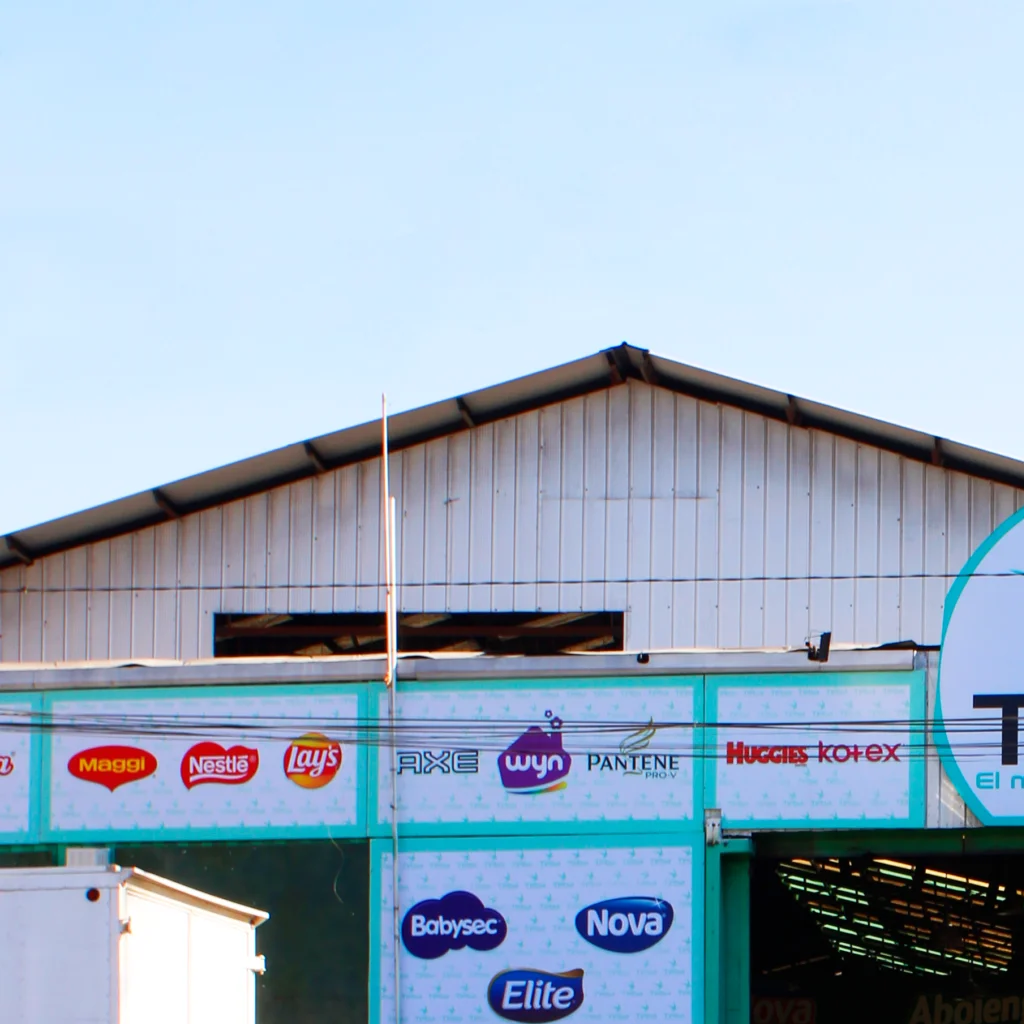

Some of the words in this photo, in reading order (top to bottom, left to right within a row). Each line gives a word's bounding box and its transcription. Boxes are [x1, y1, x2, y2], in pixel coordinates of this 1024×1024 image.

[287, 745, 339, 777] Lay's
[397, 751, 479, 774] AXE
[587, 754, 680, 772] PANTENE
[726, 741, 809, 764] HUGGIES
[817, 740, 902, 763] kotex
[79, 757, 146, 773] Maggi
[189, 755, 249, 774] Nestlé
[505, 754, 564, 778] wyn
[975, 771, 1000, 789] El
[411, 915, 498, 938] Babysec
[587, 908, 664, 937] Nova
[502, 980, 575, 1010] Elite
